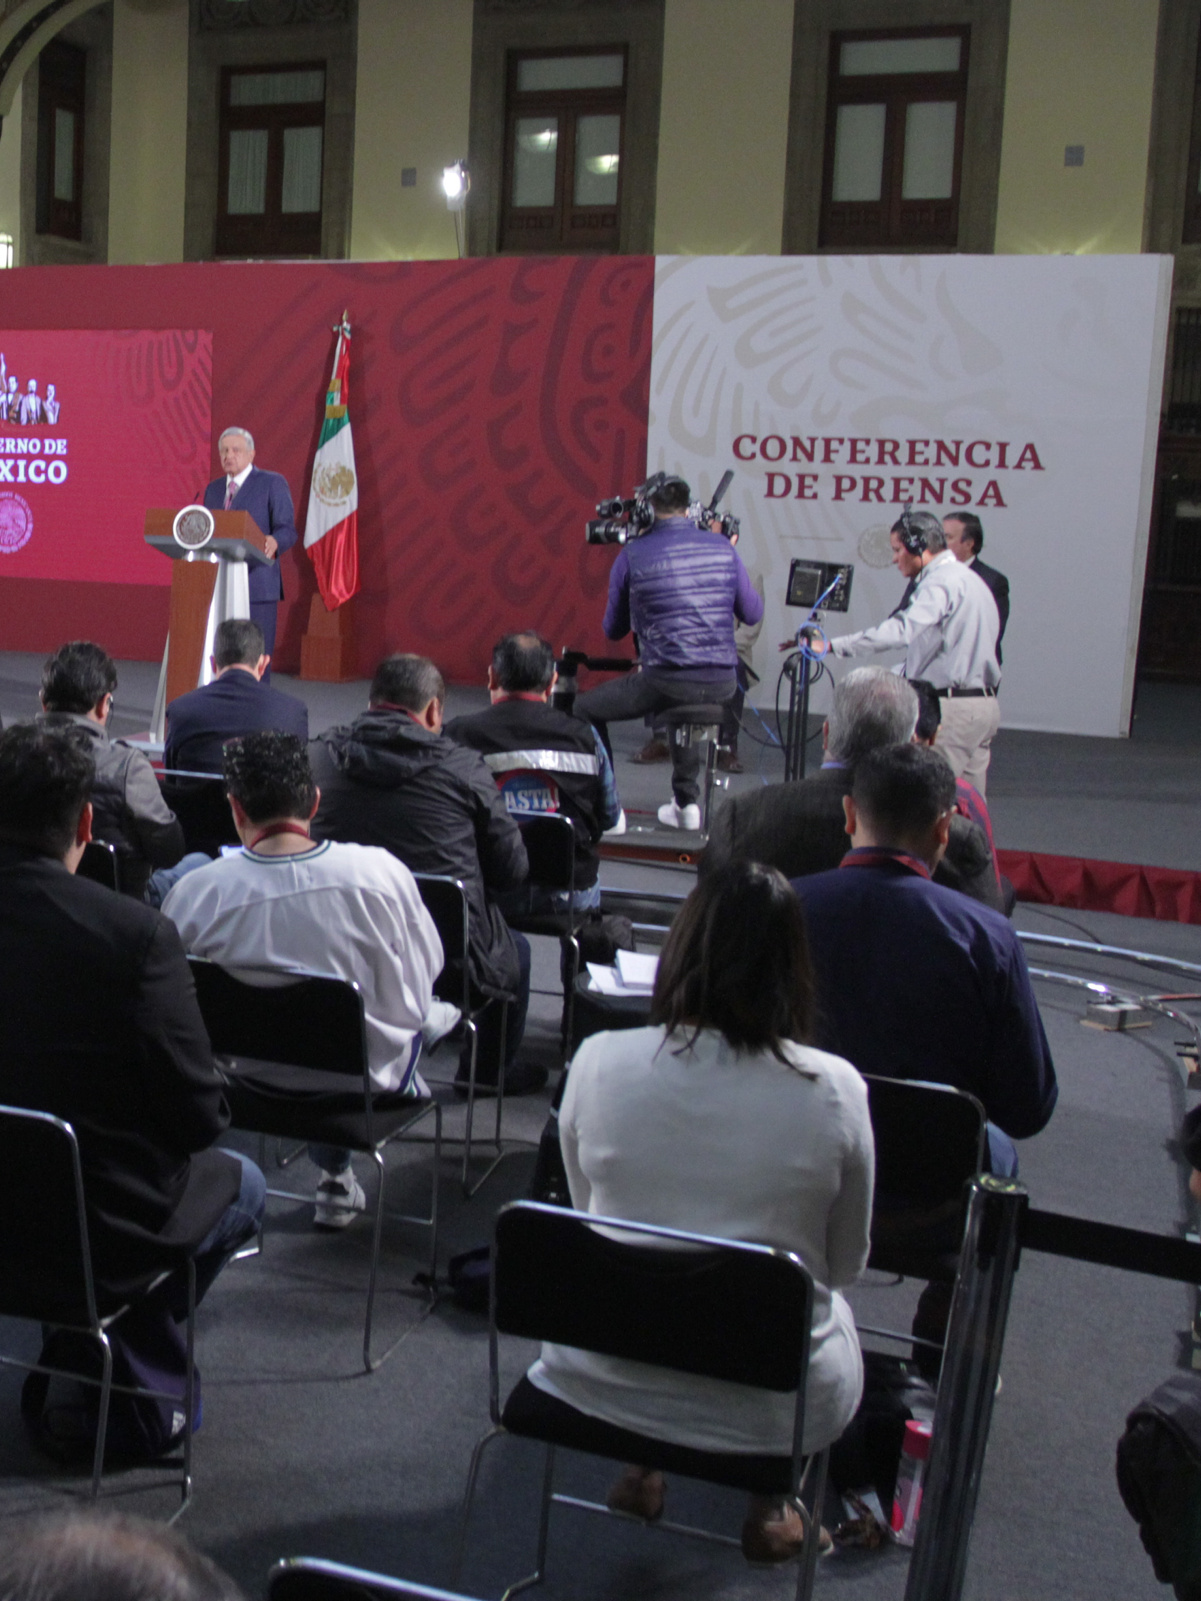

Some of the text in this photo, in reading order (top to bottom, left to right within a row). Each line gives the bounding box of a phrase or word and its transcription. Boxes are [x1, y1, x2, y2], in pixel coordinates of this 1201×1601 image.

[43, 438, 68, 455] DE
[732, 434, 1046, 471] CONFERENCIA
[763, 472, 1008, 508] DE PRENSA
